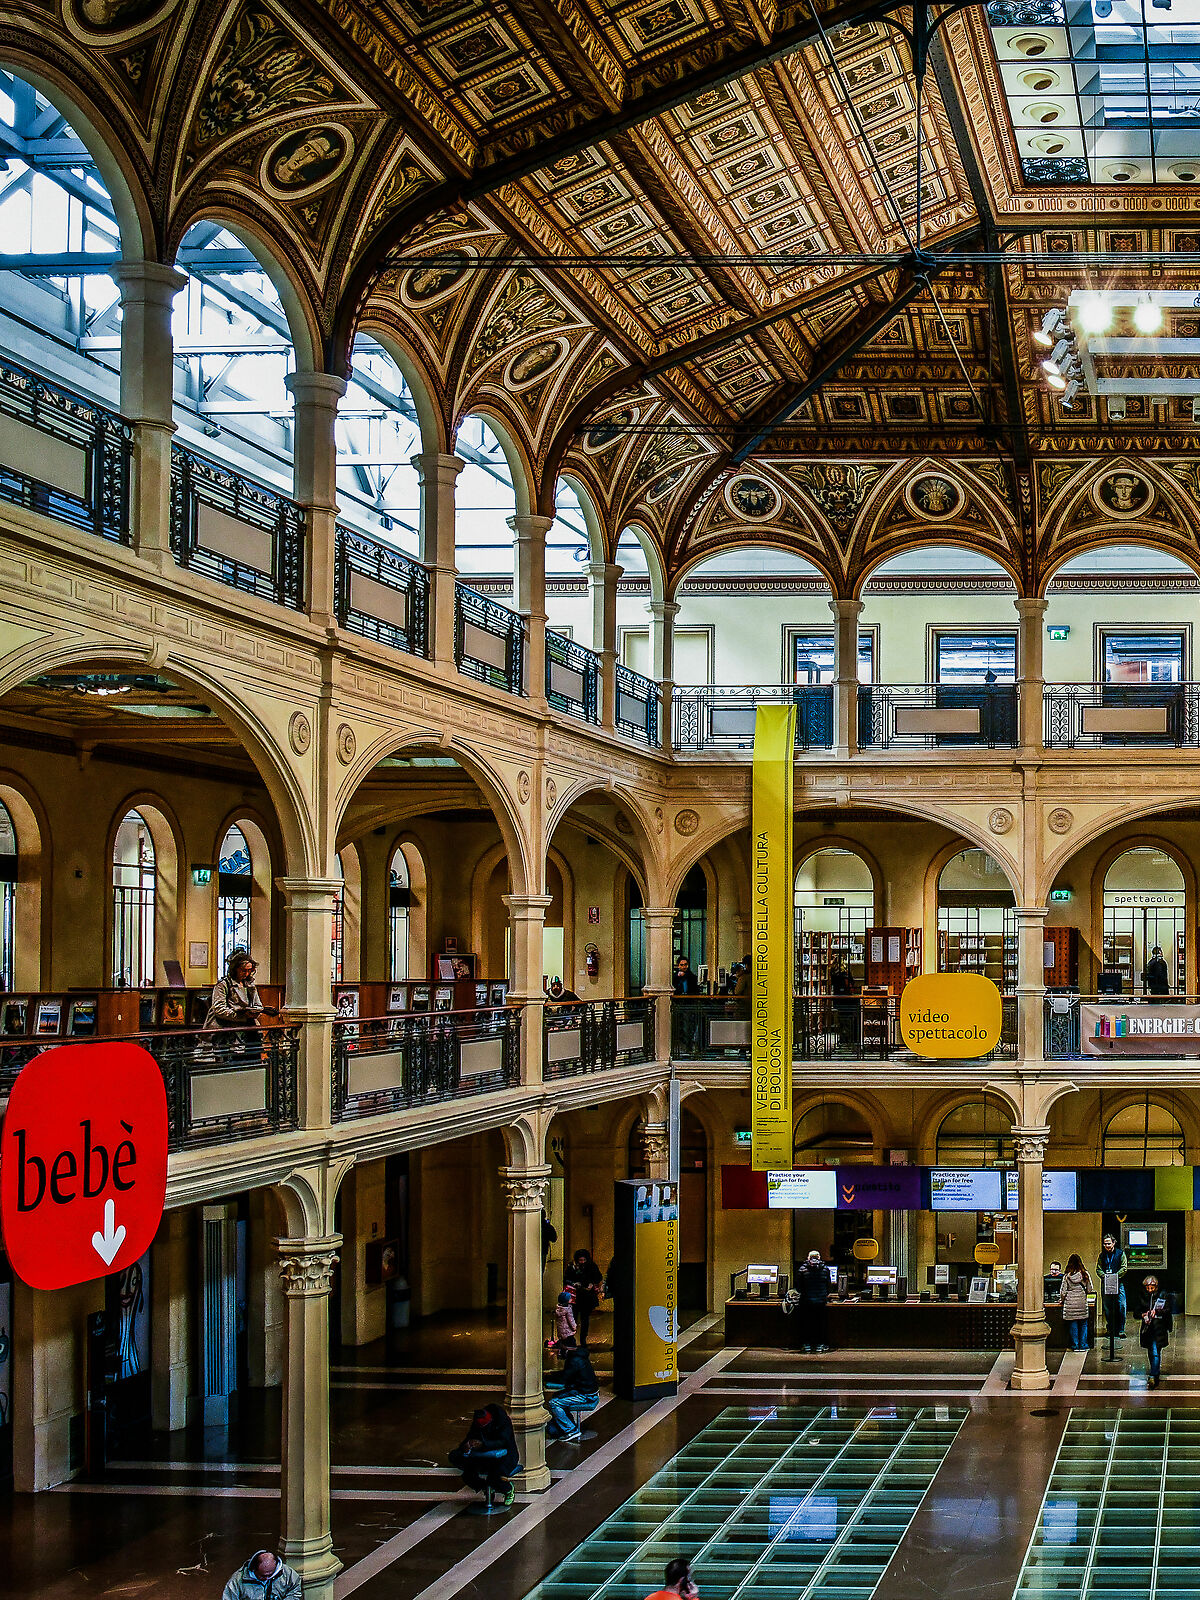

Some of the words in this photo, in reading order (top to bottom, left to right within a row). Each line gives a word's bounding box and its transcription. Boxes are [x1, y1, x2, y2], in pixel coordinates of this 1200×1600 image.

[756, 831, 769, 895] CULTURA
[1114, 895, 1175, 904] spettacolo
[756, 897, 769, 941] DELLA
[756, 944, 769, 1048] QUADRILATERO
[908, 1009, 950, 1024] video
[1129, 1017, 1186, 1034] ENERGIE
[908, 1025, 988, 1043] spettacolo
[756, 1051, 769, 1063] IL
[770, 1028, 782, 1094] BOLOGNA
[756, 1065, 769, 1111] VERSO
[770, 1098, 782, 1111] DI
[13, 1119, 137, 1212] bebè
